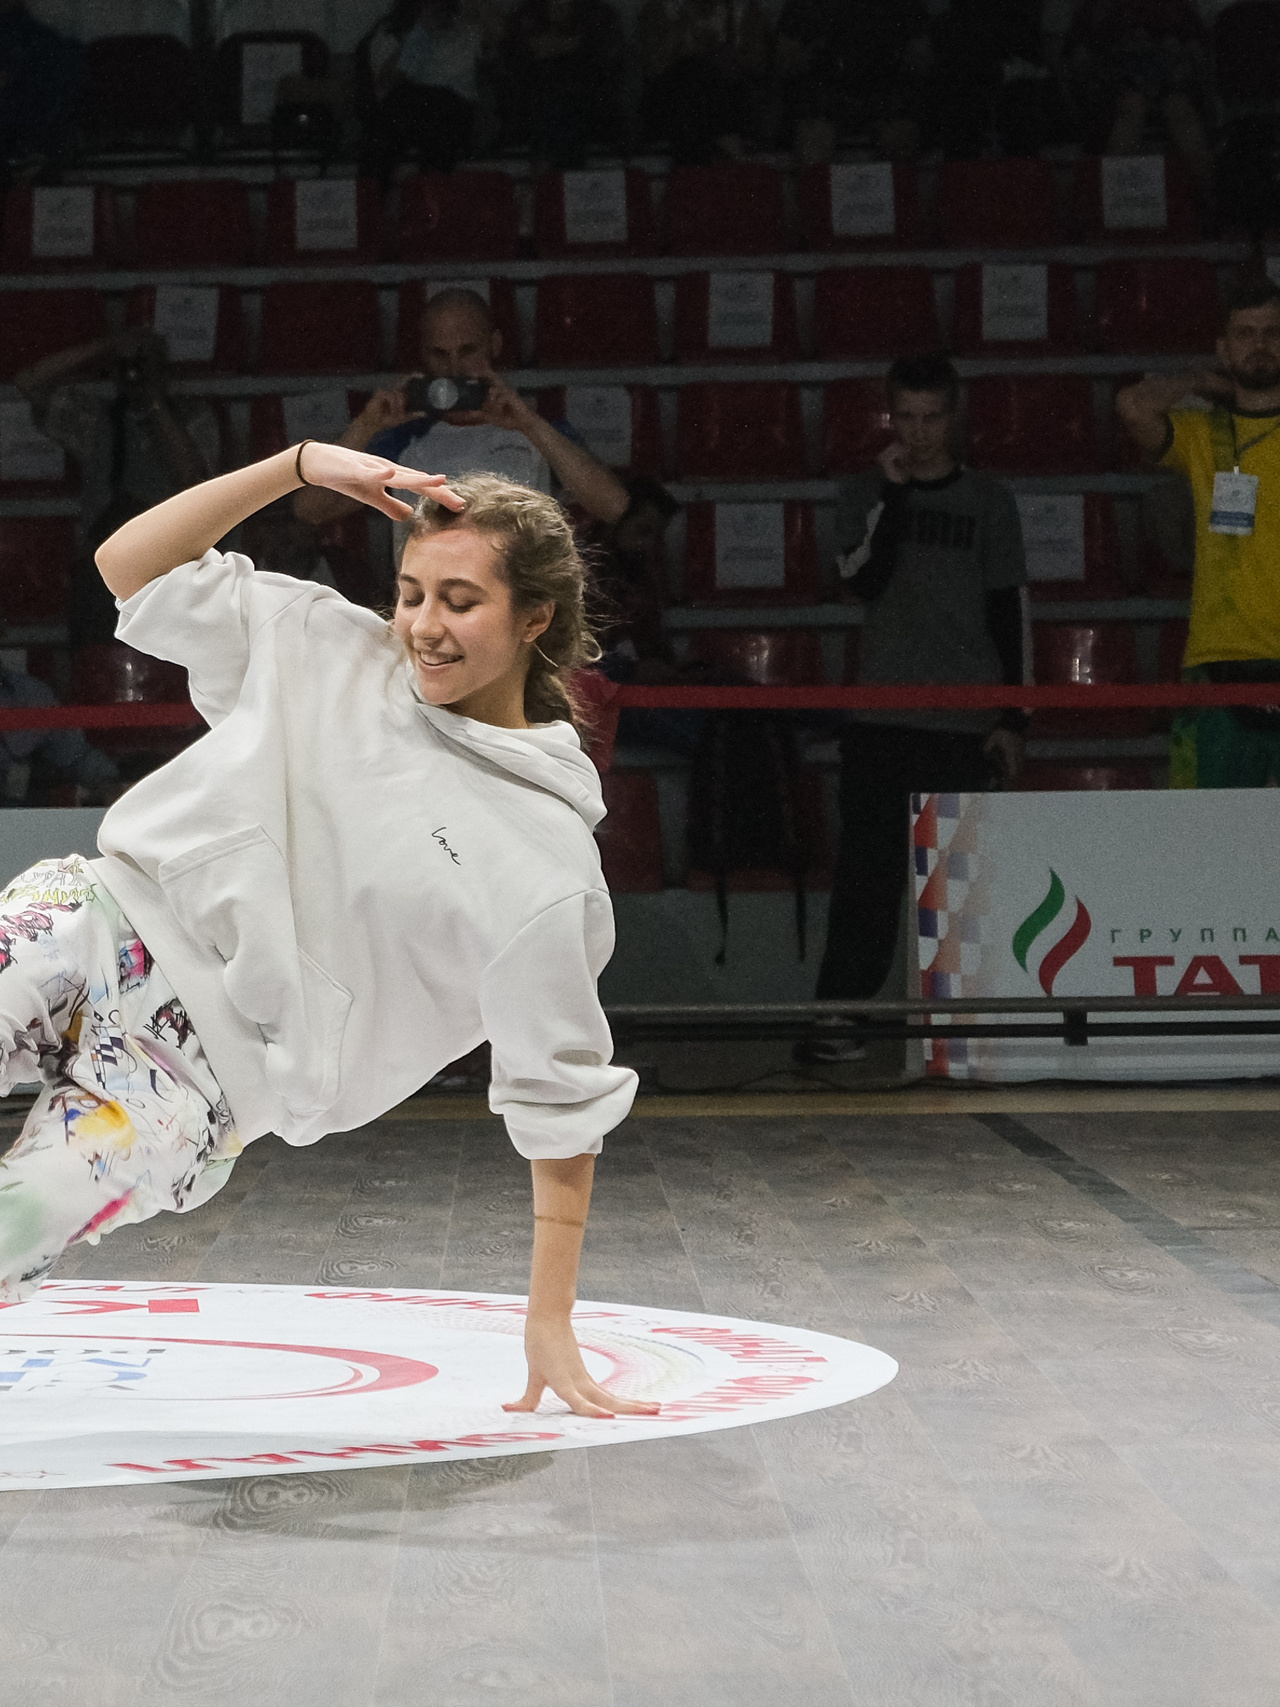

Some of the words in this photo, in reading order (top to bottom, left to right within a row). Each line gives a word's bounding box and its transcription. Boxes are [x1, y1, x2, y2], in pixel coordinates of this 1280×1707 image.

[1110, 927, 1280, 943] ГРУППА
[651, 1326, 828, 1364] ФИНАЛ
[106, 1431, 566, 1473] ФИНАЛ
